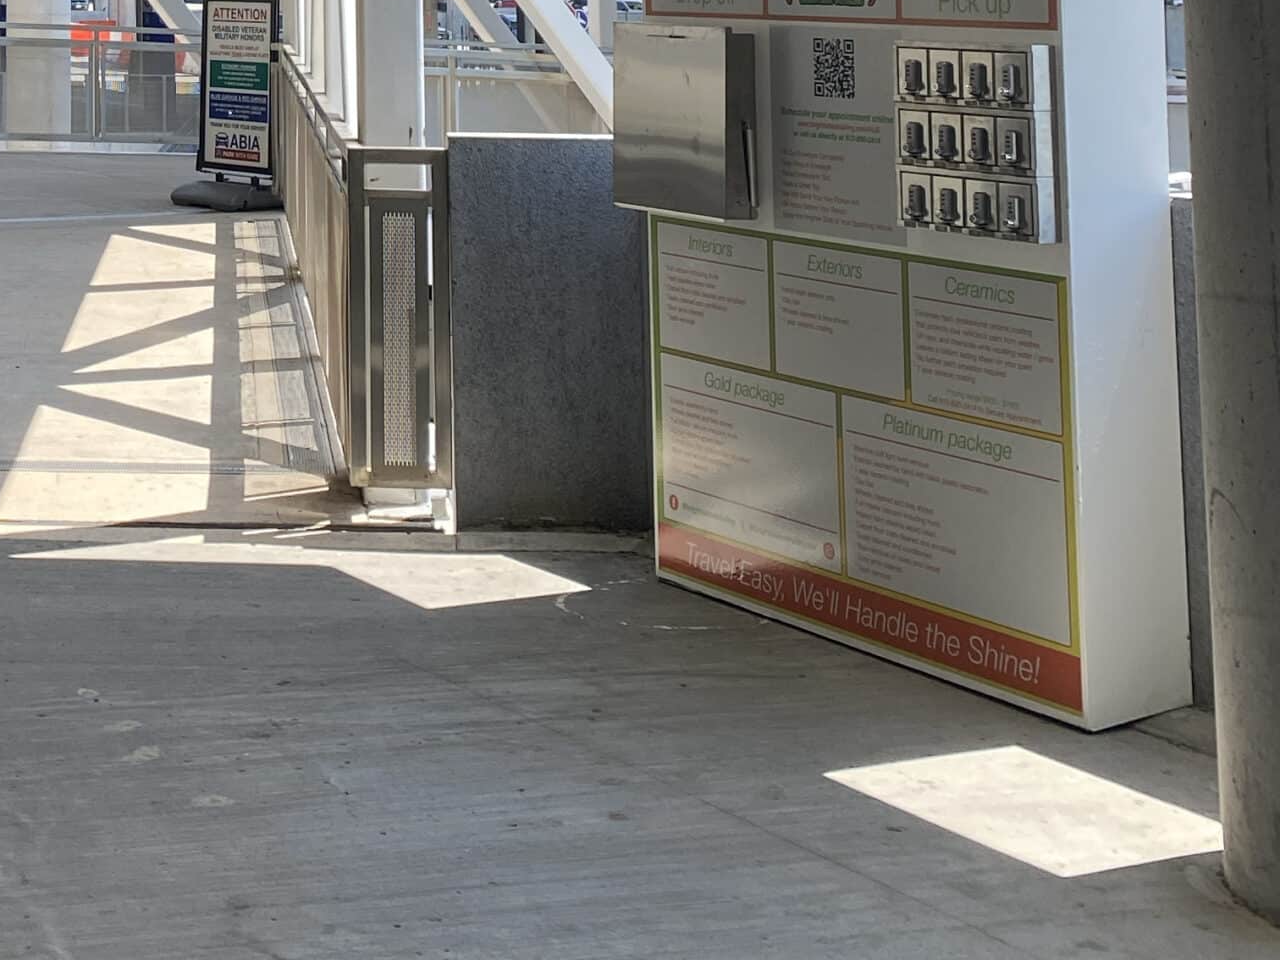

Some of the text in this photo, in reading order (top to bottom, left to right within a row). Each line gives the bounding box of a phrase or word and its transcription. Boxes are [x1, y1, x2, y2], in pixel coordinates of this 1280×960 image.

[212, 7, 268, 20] ATTENTION
[212, 25, 267, 35] DISABLED VETERAN
[214, 32, 239, 41] MILITARY
[230, 133, 261, 152] ABIA
[688, 235, 733, 257] Interiors
[807, 254, 863, 280] Exteriors
[944, 276, 1016, 305] Ceramics
[704, 371, 732, 393] Gold
[734, 381, 785, 409] package
[883, 412, 944, 444] Platinum
[947, 431, 1013, 463] package
[687, 542, 1041, 685] Travel Easy, We'll Handle the Shine!
